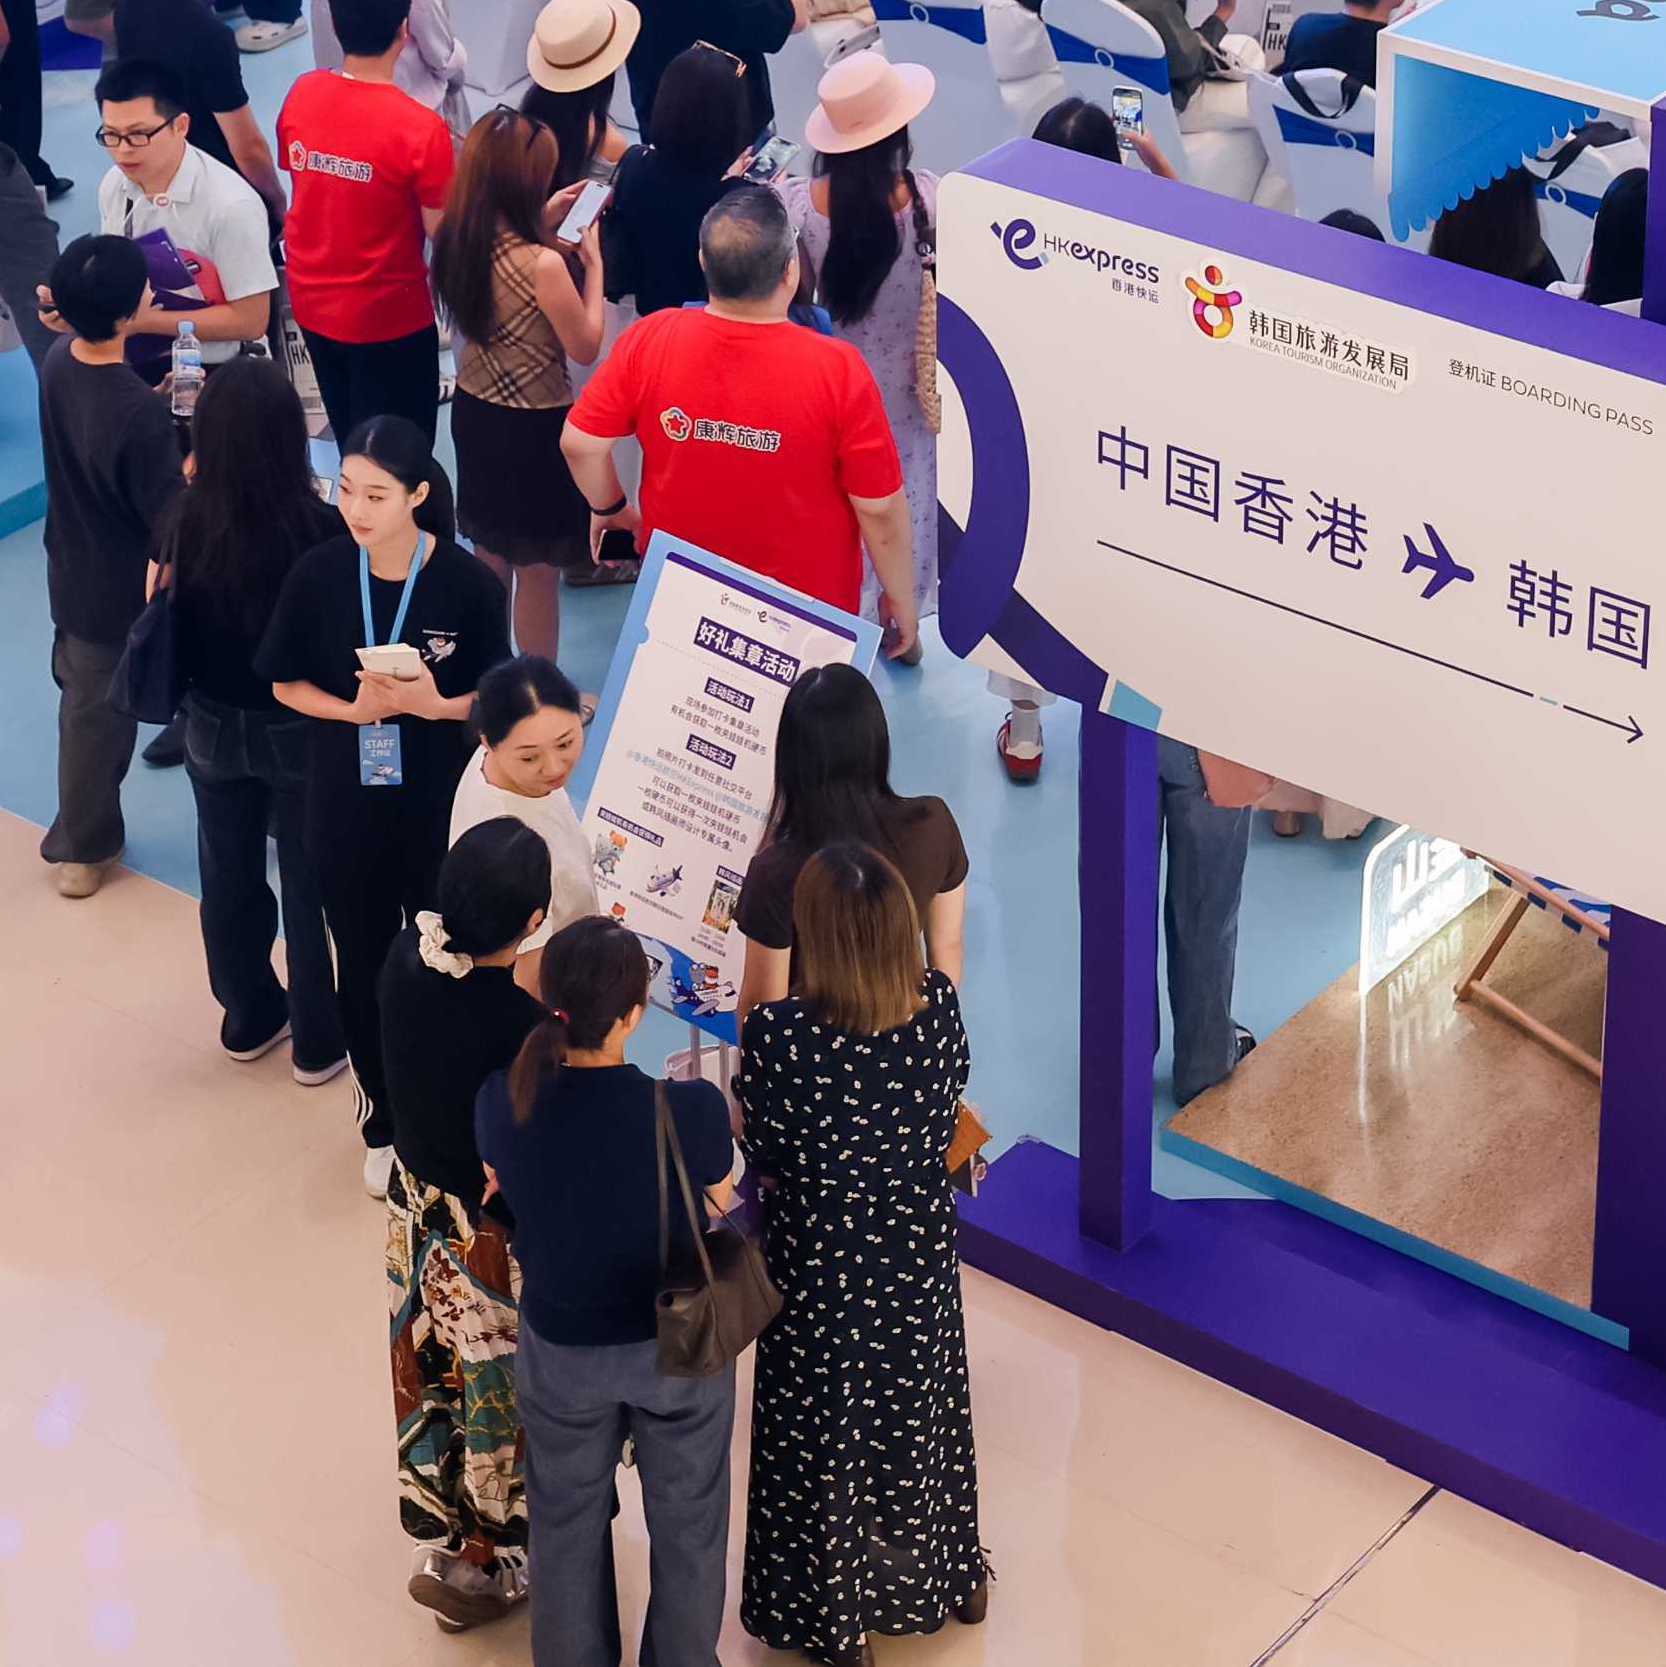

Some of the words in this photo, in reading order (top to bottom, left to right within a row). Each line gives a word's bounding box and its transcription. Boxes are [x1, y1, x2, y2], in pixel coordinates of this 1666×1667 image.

[1043, 231, 1161, 285] HKexpress
[1111, 278, 1161, 305] 香港快运
[1249, 308, 1410, 382] 韩国旅游发展局
[1249, 335, 1281, 356] KOREA
[1281, 342, 1324, 368] TOURISM
[1324, 353, 1398, 391] ORGANIZATION
[1447, 357, 1497, 390] 登机证
[1500, 374, 1602, 420] BOARDING
[1605, 407, 1655, 436] PASS
[693, 417, 781, 453] 康辉旅游
[1096, 424, 1369, 571] 中国香港
[1506, 559, 1652, 670] 韩国
[696, 621, 795, 683] 好礼集章活动
[365, 739, 396, 750] STAFF
